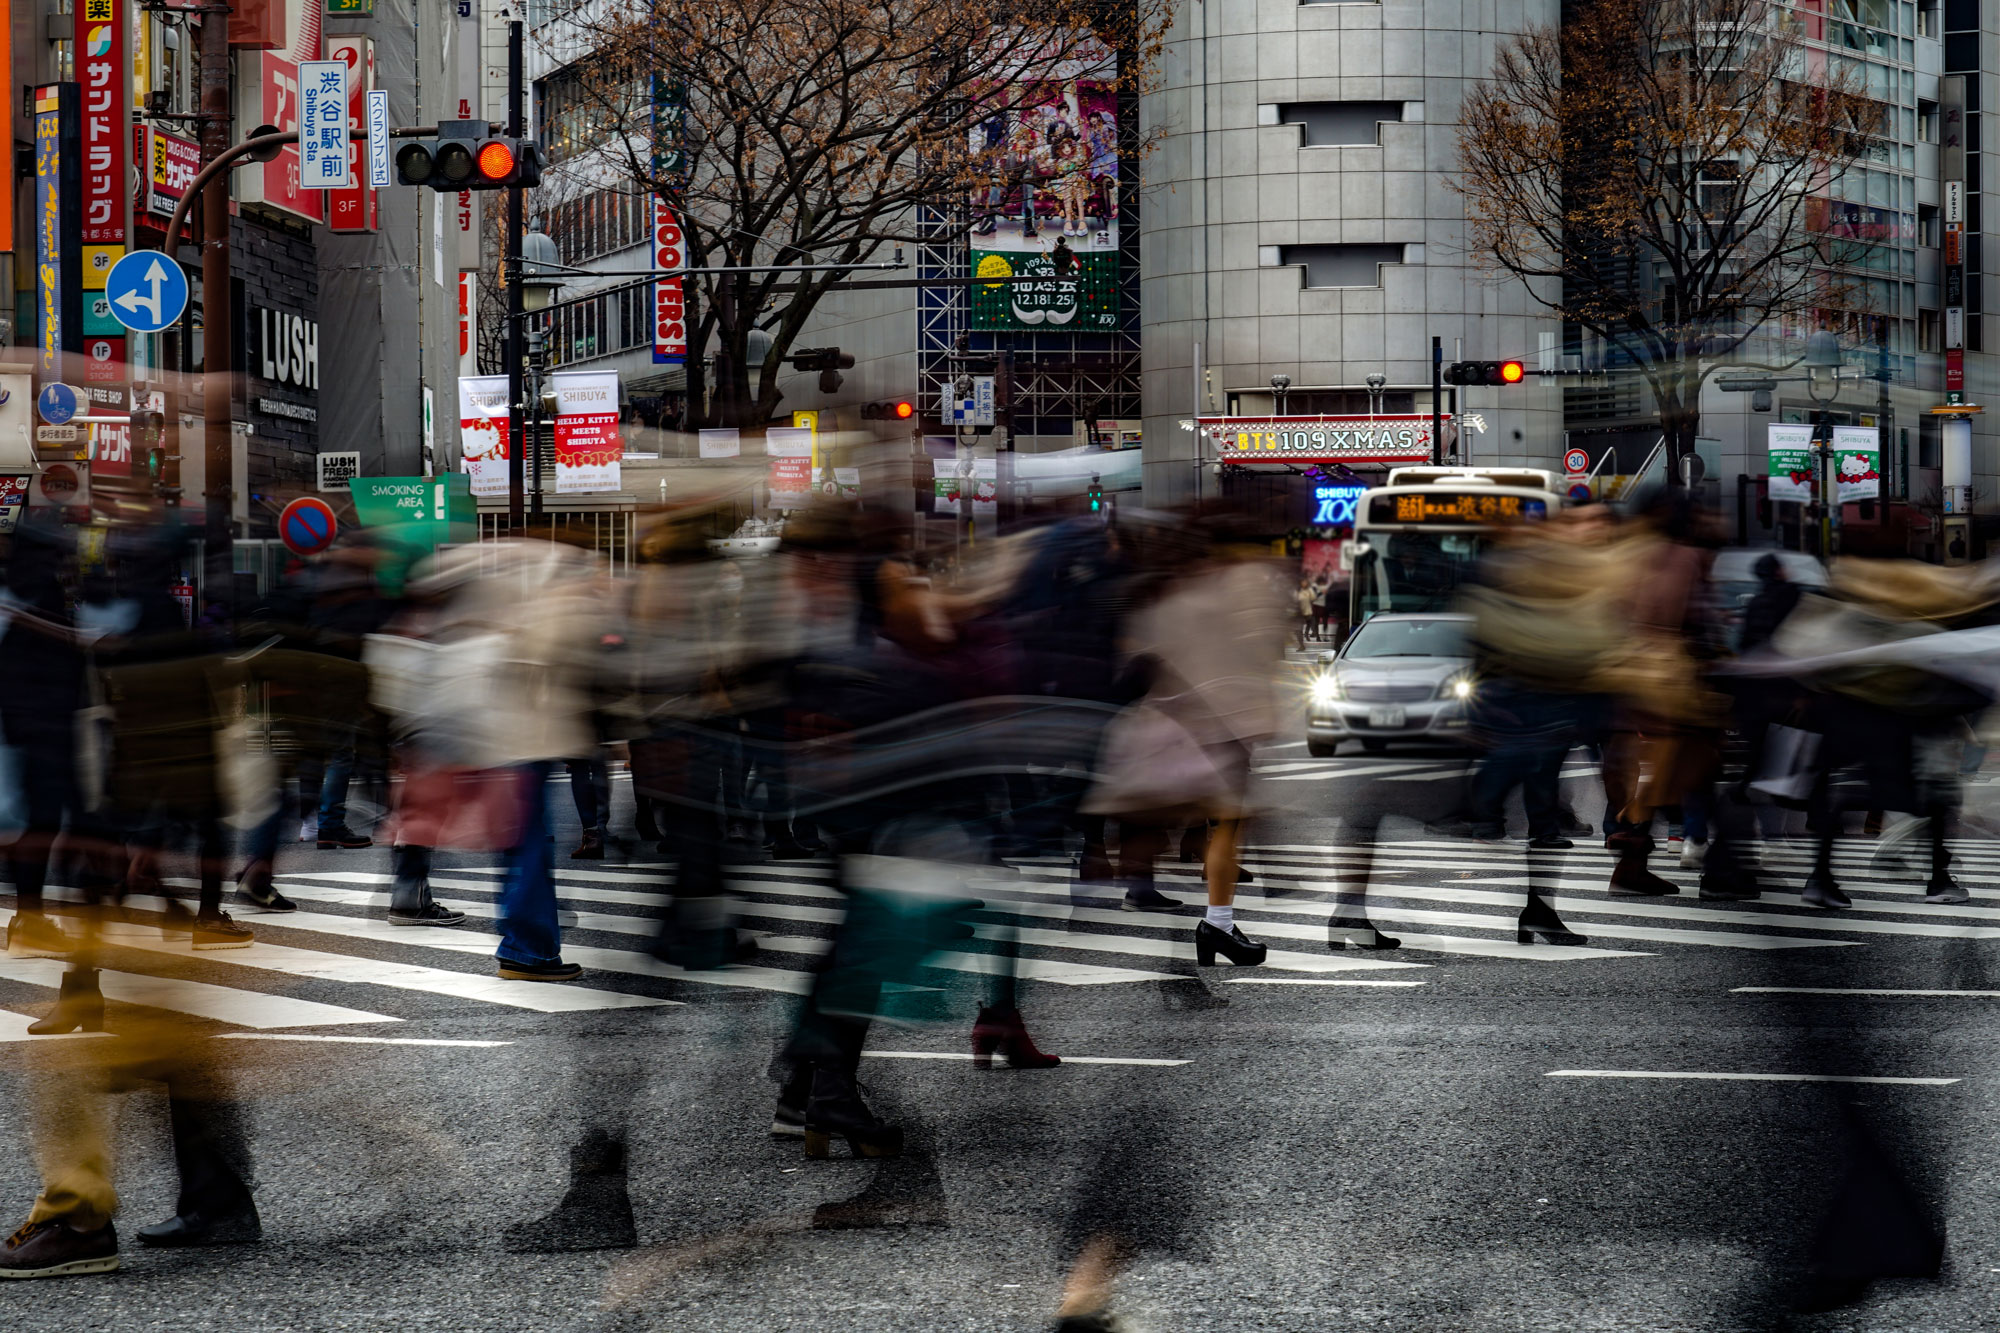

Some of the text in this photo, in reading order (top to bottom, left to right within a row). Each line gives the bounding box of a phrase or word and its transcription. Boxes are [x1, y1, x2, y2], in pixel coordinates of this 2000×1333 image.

[304, 88, 318, 165] Shibuya Sta.
[320, 71, 343, 178] 渋谷駅前
[87, 62, 113, 225] サンドラッグ
[372, 96, 386, 182] スクランブル式
[338, 201, 357, 212] 3F
[94, 256, 109, 267] 3F
[1056, 293, 1071, 306] 25
[94, 302, 109, 314] 2F
[95, 346, 109, 357] 1F
[261, 308, 319, 390] LUSH
[90, 363, 113, 371] DRUG
[89, 372, 114, 380] STORE
[93, 389, 108, 403] FREE
[108, 390, 123, 404] SHOP
[563, 391, 608, 403] SHIBUYA
[557, 415, 616, 426] HELLO KITTY
[571, 427, 602, 436] MEETS
[566, 437, 607, 446] SHIBUYA
[1237, 430, 1413, 451] BTS 109 XMAS
[1840, 436, 1871, 444] SHIBUYA
[322, 456, 356, 467] LUSH
[1569, 454, 1584, 467] 30
[322, 467, 356, 476] FRESH
[322, 475, 356, 483] HANDMA
[371, 484, 425, 496] SMOKING
[825, 484, 834, 494] 4
[396, 497, 425, 508] AREA
[1457, 496, 1520, 516] 渋谷駅
[1944, 501, 1953, 511] 2
